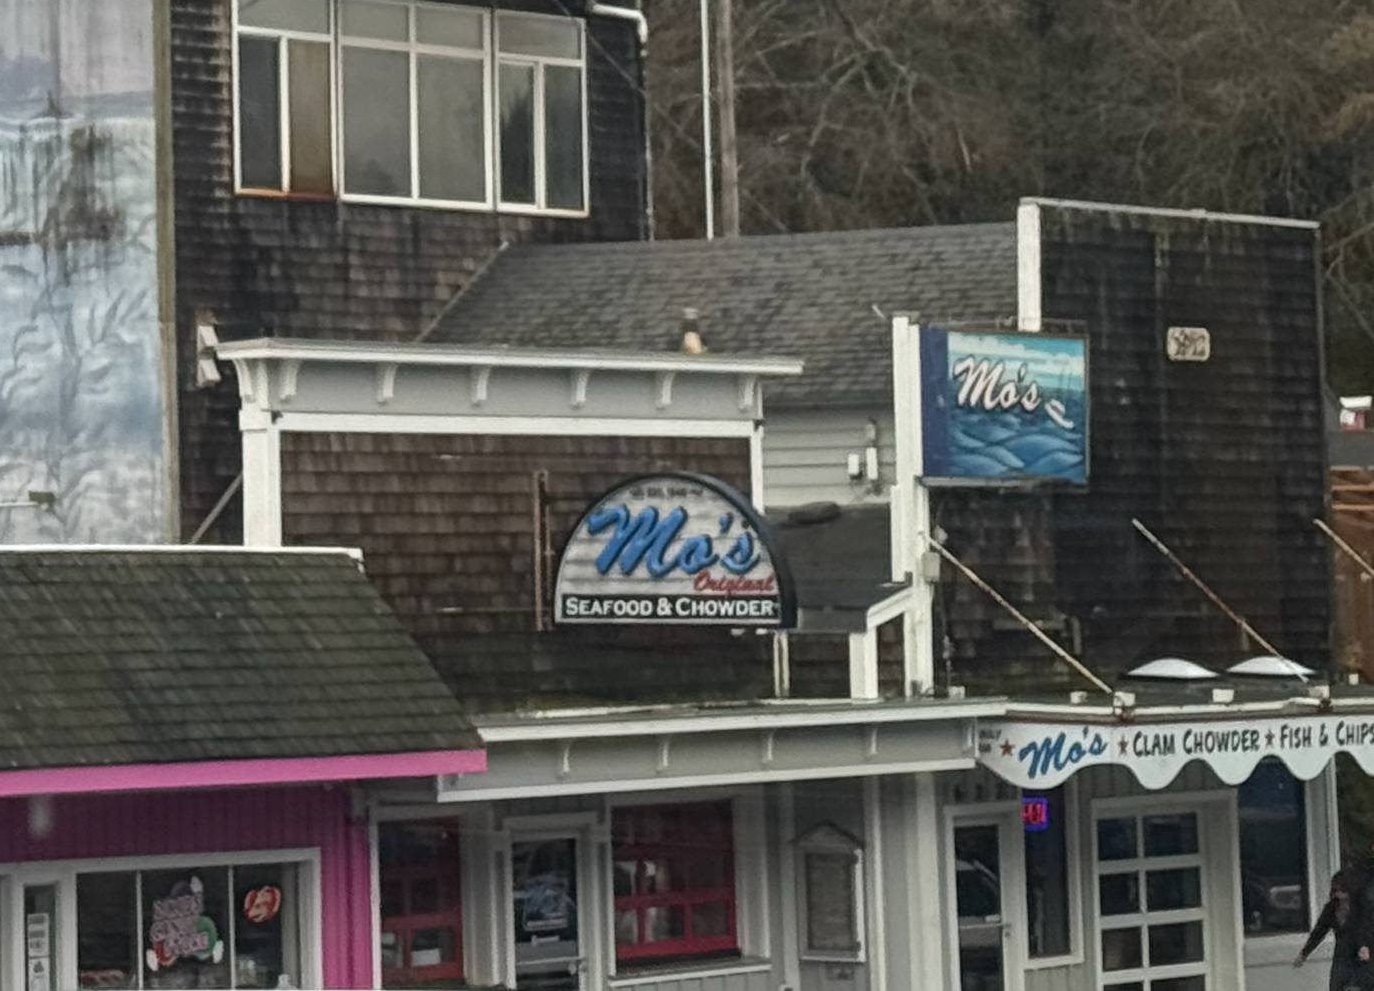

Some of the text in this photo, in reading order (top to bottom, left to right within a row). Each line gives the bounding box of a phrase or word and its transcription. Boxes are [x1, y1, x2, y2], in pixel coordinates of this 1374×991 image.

[952, 354, 1043, 412] Mo's
[587, 503, 761, 578] Mo's
[565, 596, 774, 617] SEAFOOD & CHOWDER
[693, 569, 775, 598] Original
[1018, 726, 1109, 779] Mo's
[1132, 730, 1176, 757] CLAM
[1182, 728, 1261, 755] CHOWDER
[1279, 723, 1313, 750] FISH
[1319, 722, 1329, 747] &
